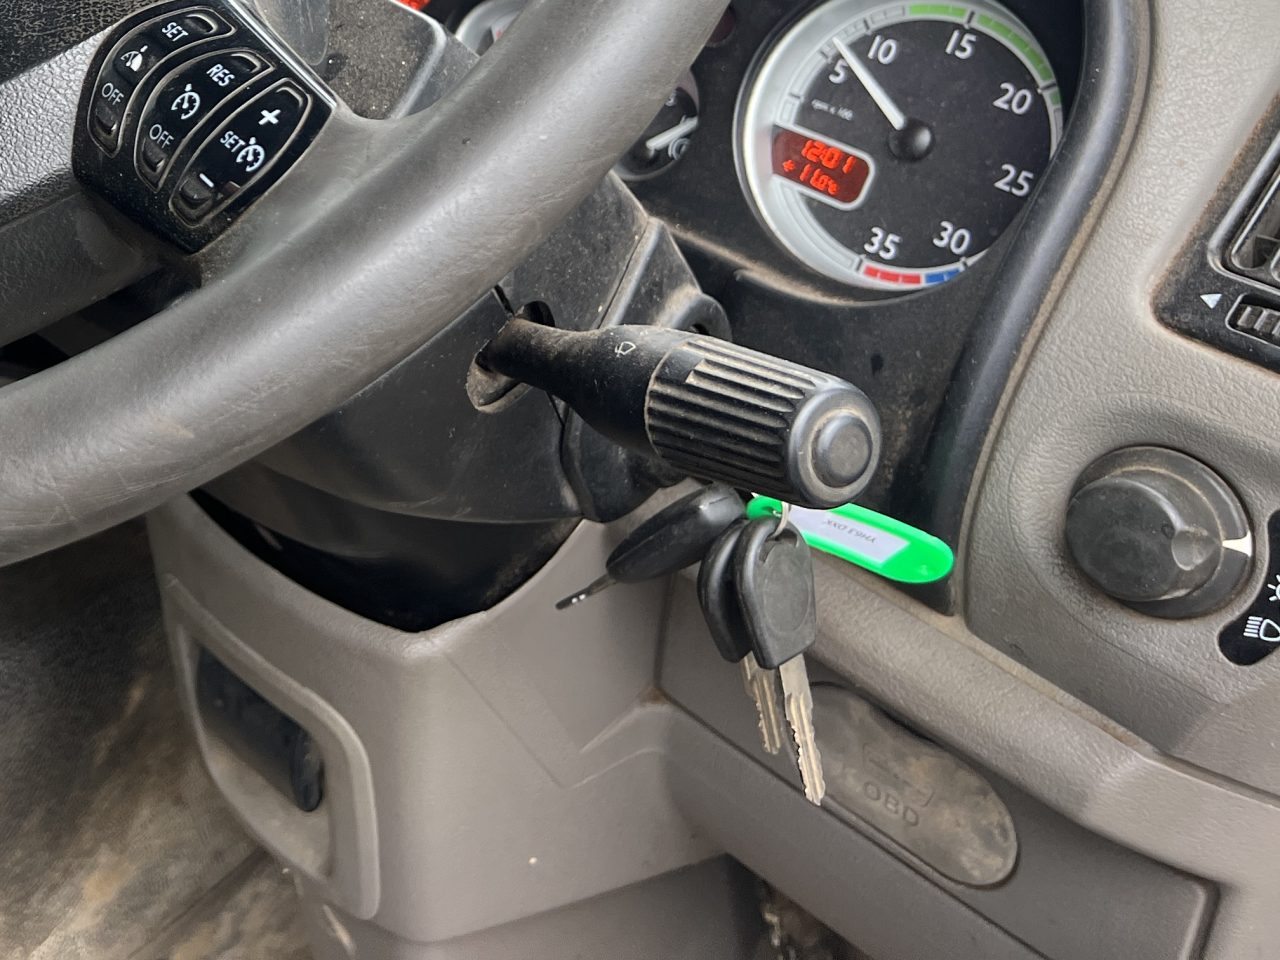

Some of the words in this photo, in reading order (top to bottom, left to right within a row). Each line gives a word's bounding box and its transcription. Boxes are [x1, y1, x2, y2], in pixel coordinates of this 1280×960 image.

[161, 21, 188, 41] SET
[945, 29, 977, 60] 15
[867, 35, 898, 65] 10
[206, 63, 235, 87] RES
[828, 58, 848, 84] 5
[101, 82, 124, 105] OFF
[993, 82, 1032, 115] 20
[149, 123, 174, 148] OFF
[220, 130, 245, 153] SET
[994, 164, 1034, 197] 25
[863, 226, 901, 260] 35
[933, 220, 971, 255] 30
[863, 780, 919, 828] OBD
